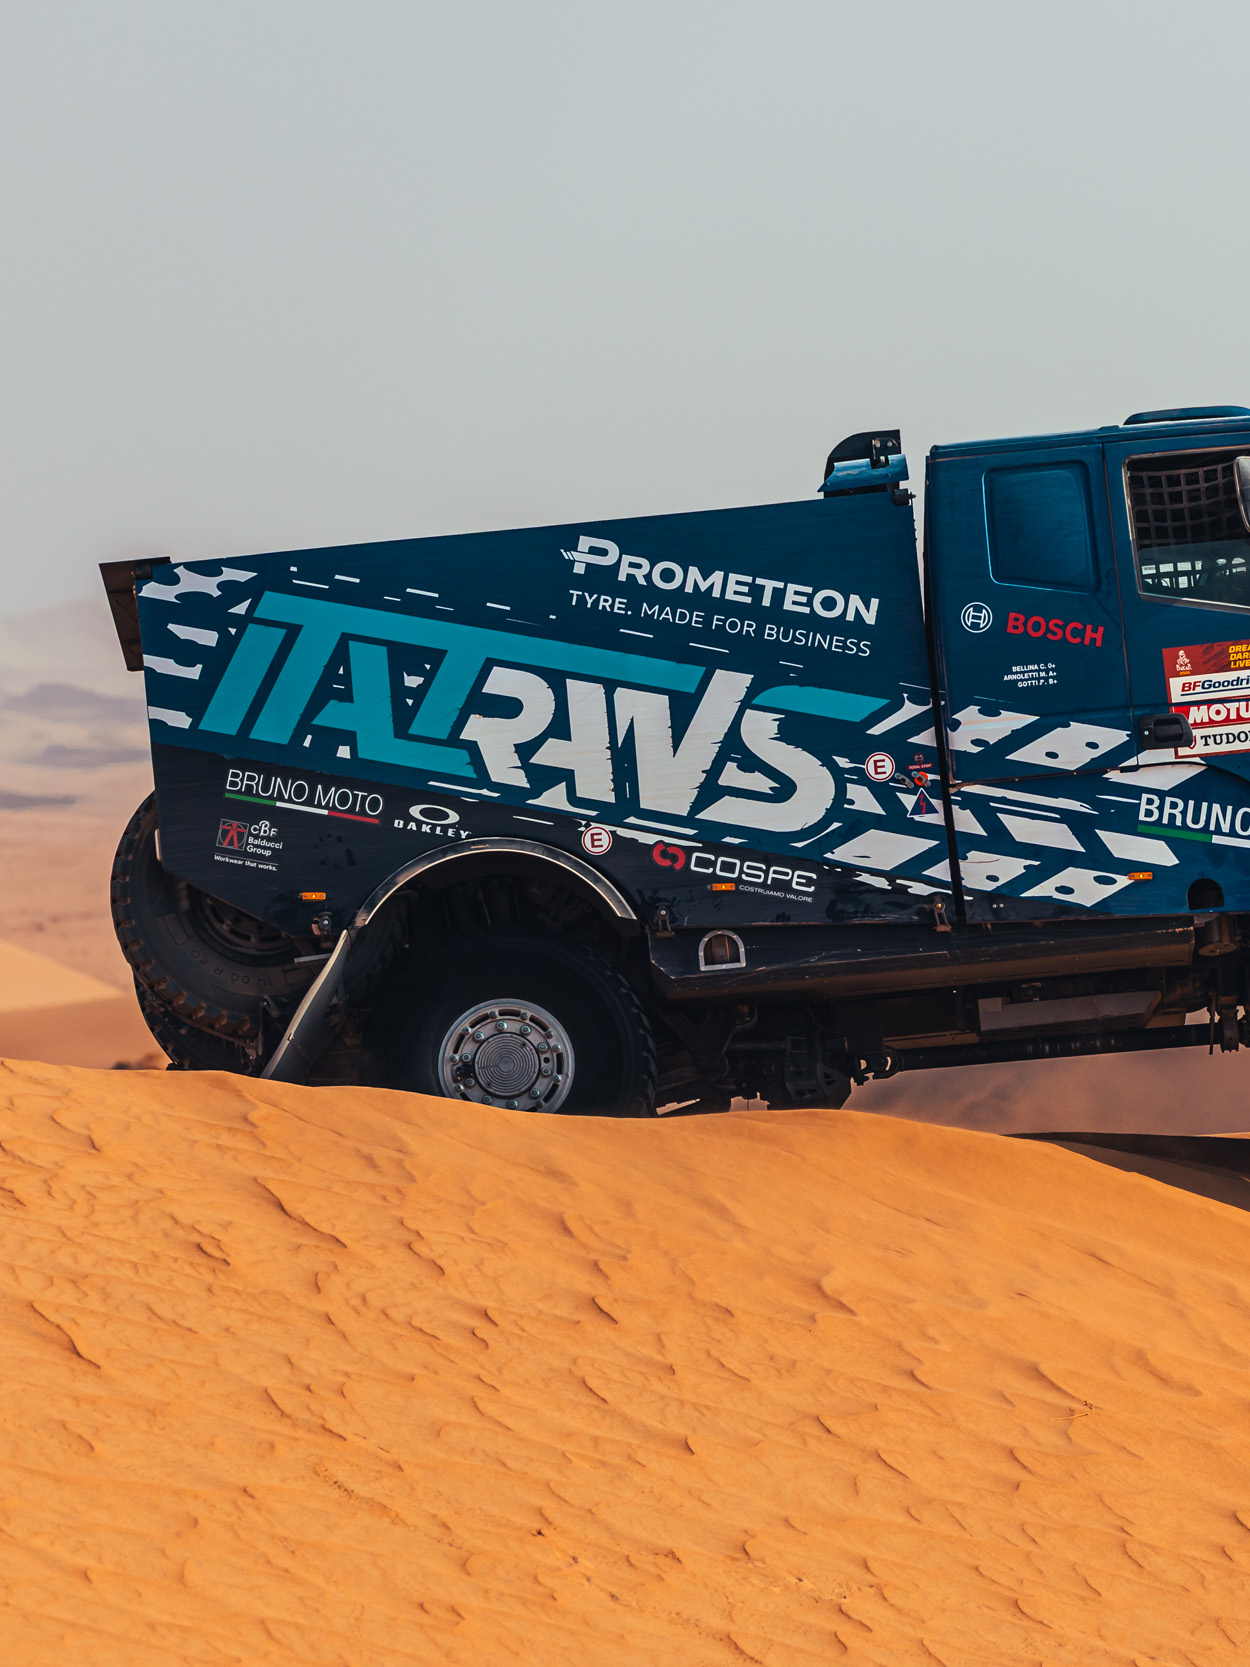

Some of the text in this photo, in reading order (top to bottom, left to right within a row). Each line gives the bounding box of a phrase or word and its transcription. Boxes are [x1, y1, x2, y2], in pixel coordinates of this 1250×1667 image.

[560, 535, 880, 626] PROMETEON
[568, 589, 872, 657] TYRE. MADE FOR BUSINESS
[1006, 612, 1105, 648] BOSCH
[1012, 664, 1039, 672] BELLINA
[1230, 659, 1250, 669] LIVE
[1003, 672, 1039, 681] ARNOLETTI
[1017, 680, 1038, 688] GOTTI
[873, 758, 887, 775] E
[225, 769, 384, 816] BRUNO MOTO
[394, 819, 470, 839] OAKLEY
[248, 836, 283, 849] Balducci
[590, 832, 604, 849] E
[246, 845, 272, 857] Group
[214, 854, 244, 865] Workwear
[244, 860, 257, 868] that
[690, 852, 818, 892] COSPE
[739, 884, 813, 902] COSTRUIAMO VALORE
